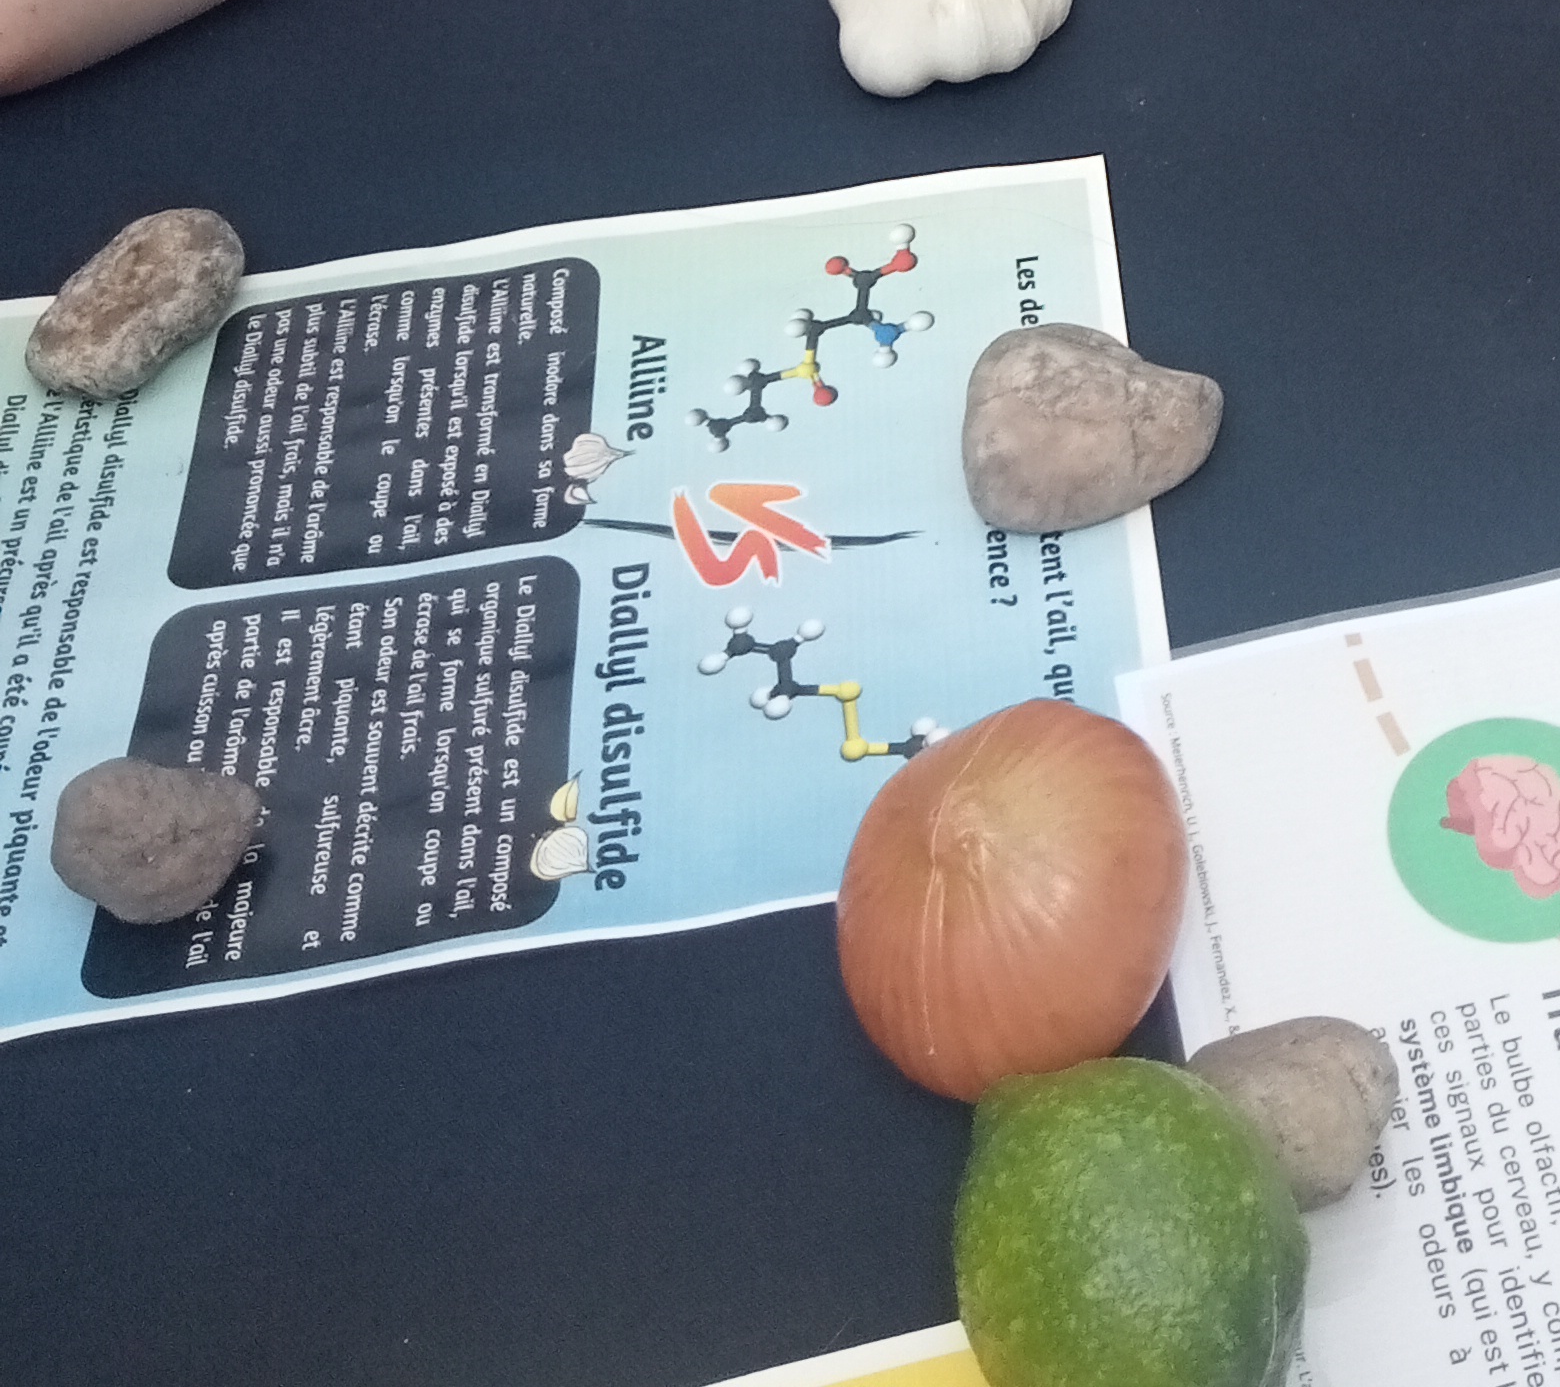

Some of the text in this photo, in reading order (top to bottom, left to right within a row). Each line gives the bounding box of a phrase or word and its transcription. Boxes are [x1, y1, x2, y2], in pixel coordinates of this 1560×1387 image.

[362, 293, 389, 352] l'écrase.
[511, 272, 537, 345] naturelle.
[531, 267, 570, 528] Composé inodore dans sa forme
[626, 333, 668, 442] Alliine
[433, 283, 480, 545] disulfide lorsqu'il est exposé à des
[462, 276, 510, 538] L'Alliine est transformé en Diallyl
[668, 480, 832, 588] VS
[293, 604, 336, 752] légèrement âcre.
[586, 561, 652, 892] Diallyl disulfide
[1429, 1010, 1507, 1247] ces signaux pour
[1454, 1001, 1552, 1286] parties du cerveau, y
[1489, 993, 1510, 1024] Le
[1501, 1035, 1534, 1107] bulbe
[1398, 1018, 1509, 1375] système limbique (qui est
[1417, 1223, 1472, 1365] odeurs à
